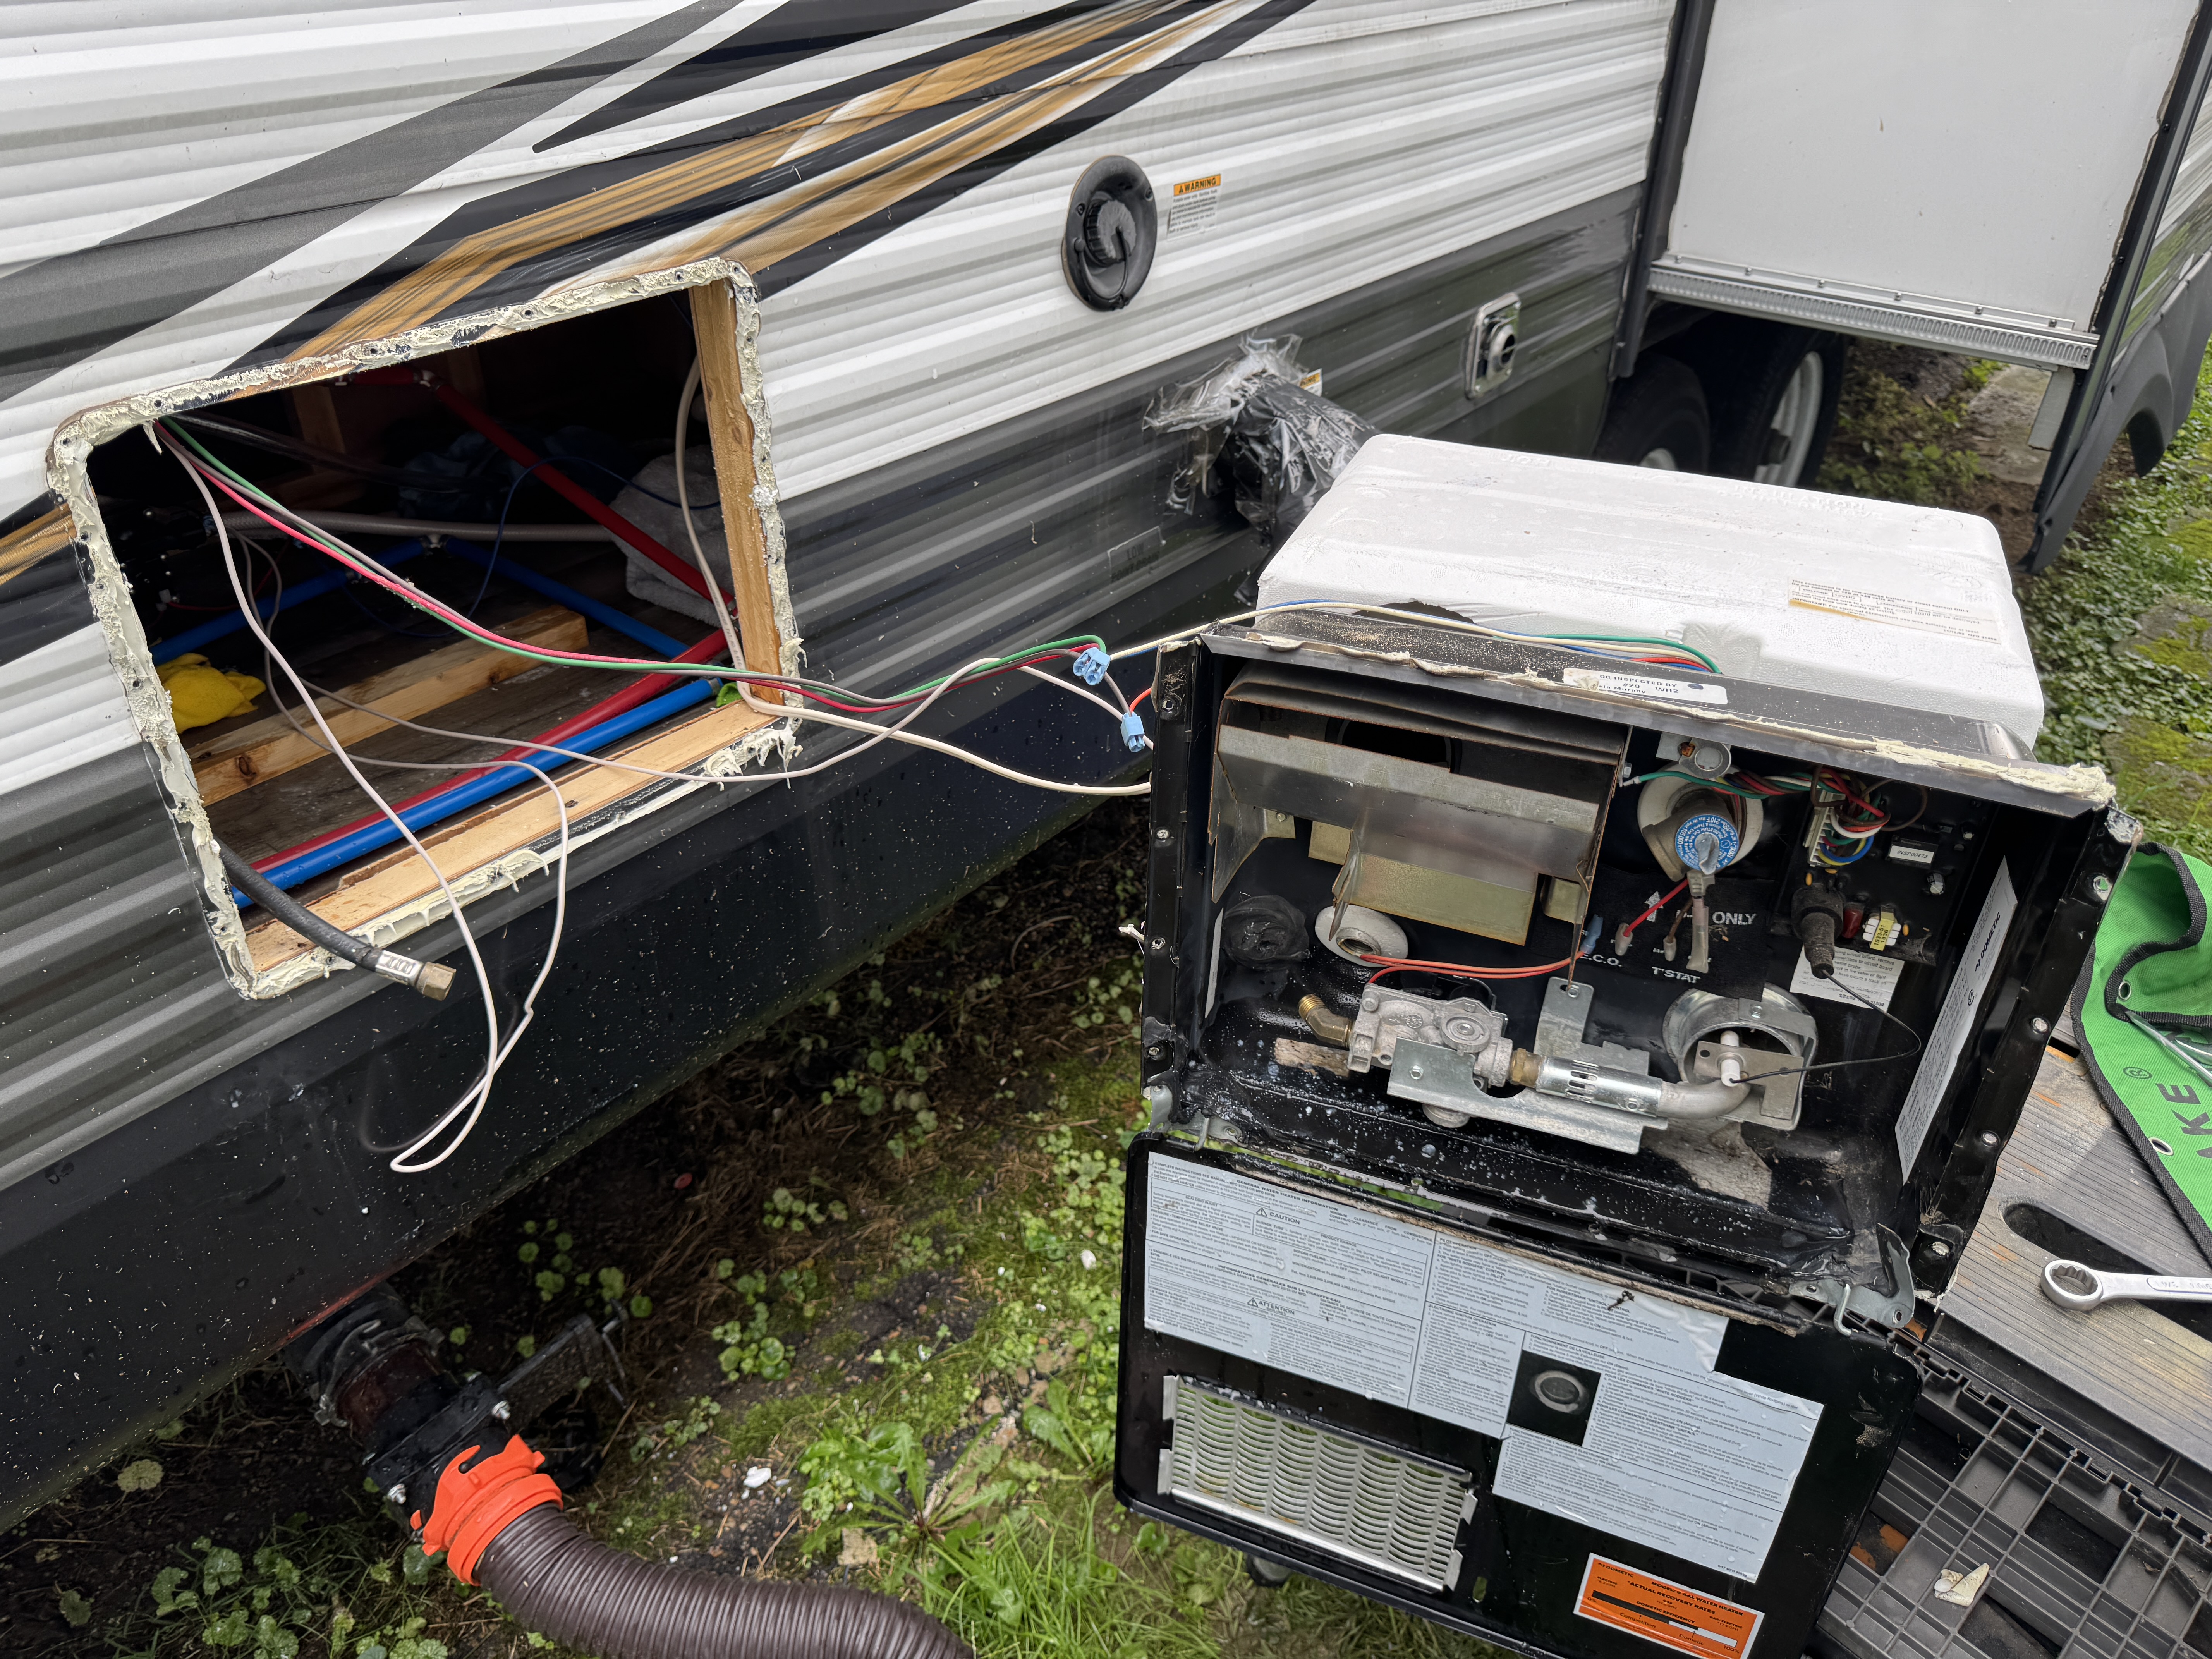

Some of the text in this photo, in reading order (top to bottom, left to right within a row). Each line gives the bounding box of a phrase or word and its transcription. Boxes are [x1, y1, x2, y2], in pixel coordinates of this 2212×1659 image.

[1184, 177, 1216, 192] WARNING
[1614, 677, 1662, 685] INSPECTED
[1677, 828, 1688, 845] 105,000
[1898, 850, 1928, 858] INSP00473
[1712, 911, 1757, 925] ONLY
[1980, 909, 2000, 961] DOMETIC
[1582, 953, 1622, 967] E.C.O.
[1652, 967, 1701, 983] T'STAT
[1269, 1211, 1300, 1224] CAUTION
[1258, 1300, 1295, 1315] ATTENTION
